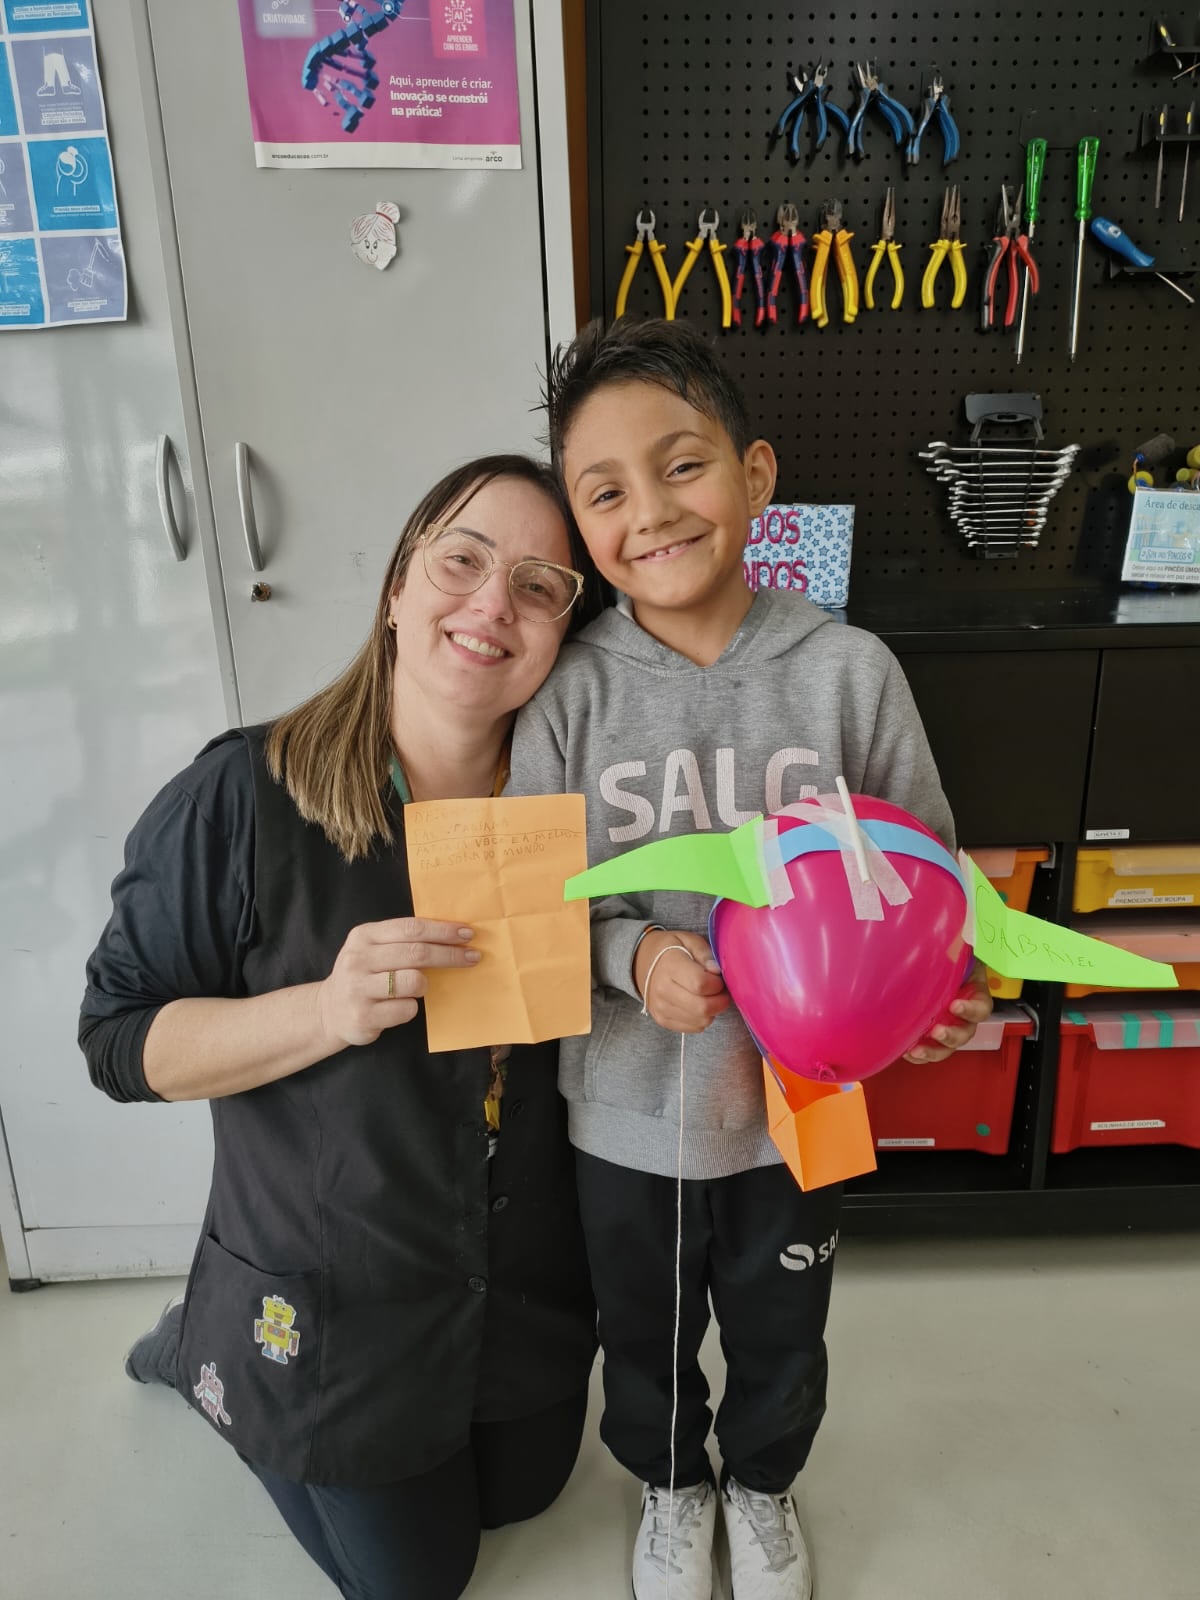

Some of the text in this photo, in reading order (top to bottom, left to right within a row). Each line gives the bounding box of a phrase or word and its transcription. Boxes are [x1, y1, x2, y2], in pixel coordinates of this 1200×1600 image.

[262, 13, 306, 25] CRIATIVIDADE
[454, 11, 463, 20] AI
[446, 35, 473, 43] APRENDER
[443, 43, 455, 51] COM
[462, 43, 478, 51] ERROS
[389, 75, 493, 90] Aqui, aprender é criar.
[390, 91, 488, 104] Inovação se constrói
[392, 105, 442, 118] na prática!
[1144, 496, 1165, 509] Área
[1167, 500, 1177, 510] de
[503, 843, 546, 857] MUNDO
[1115, 896, 1153, 904] PRENDEDOR
